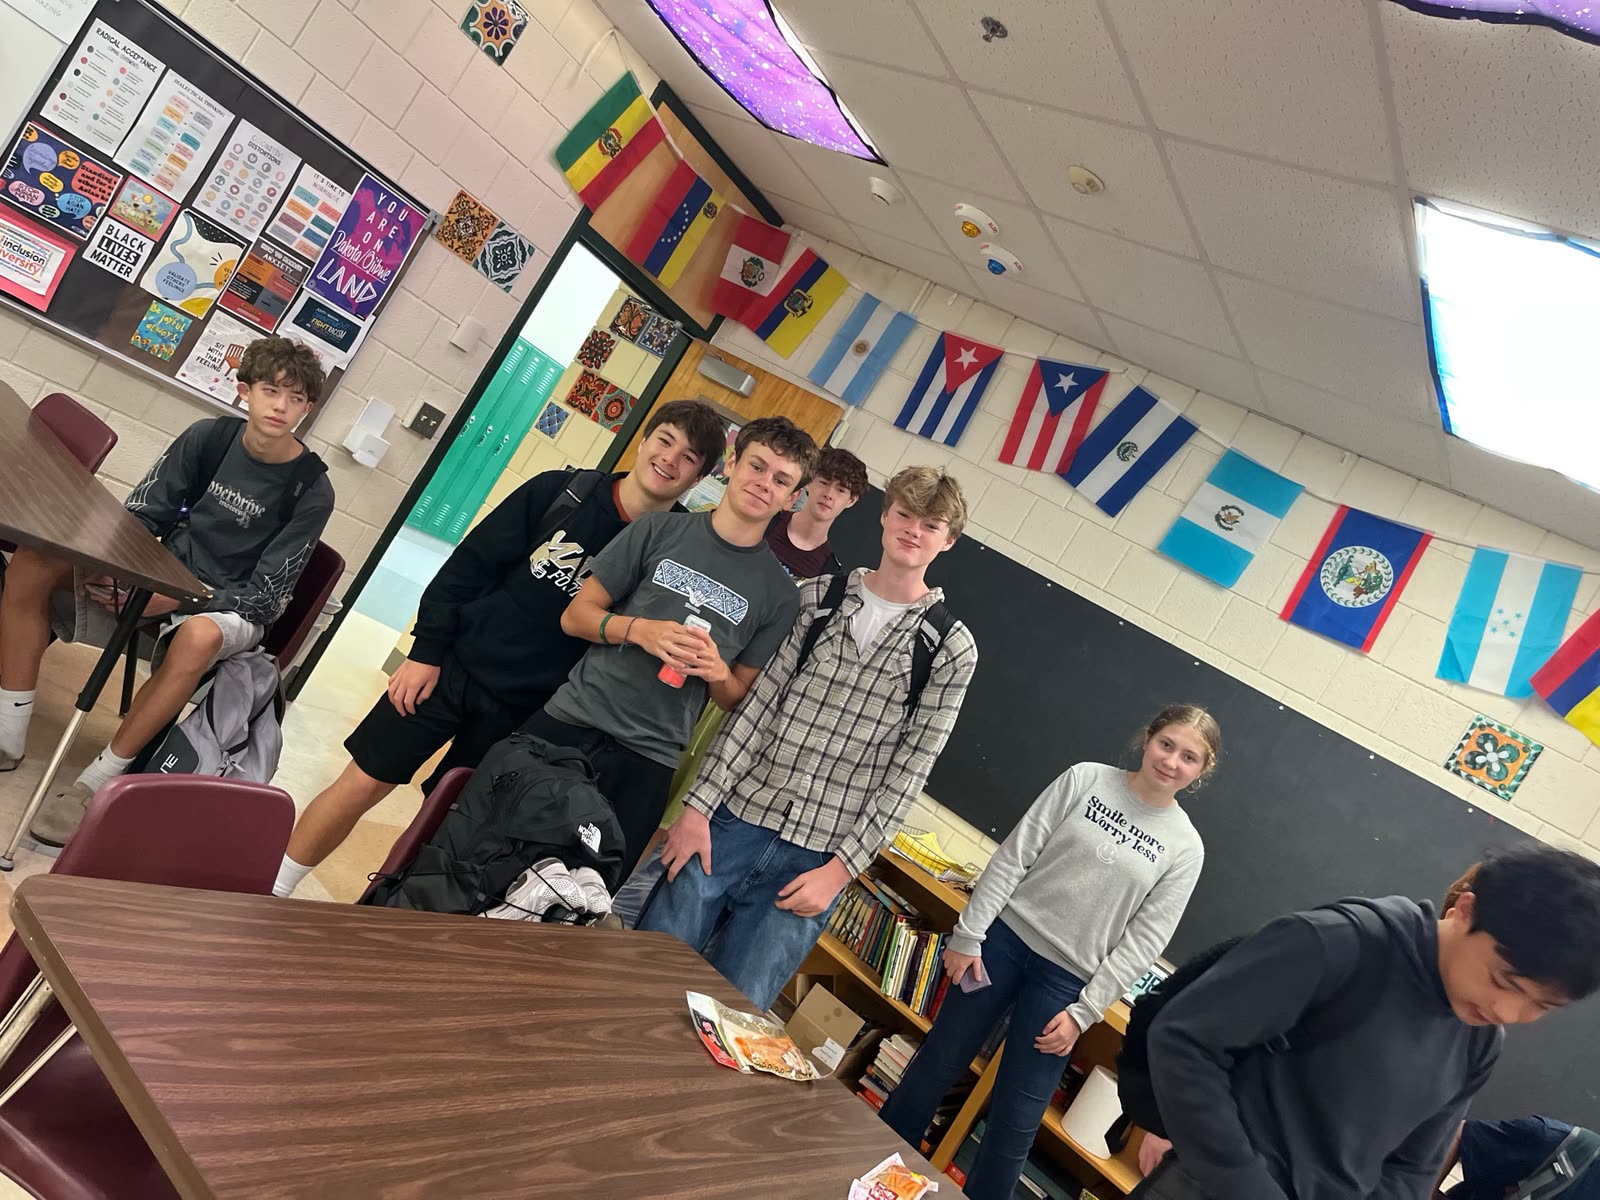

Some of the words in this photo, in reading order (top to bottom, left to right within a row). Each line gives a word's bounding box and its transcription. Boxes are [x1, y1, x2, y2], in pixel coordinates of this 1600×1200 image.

[95, 27, 122, 48] RADICAL
[121, 44, 158, 73] ACCEPTANCE
[174, 79, 202, 102] DIALECTICAL
[204, 98, 225, 118] THINKING
[248, 140, 282, 166] DISTORTIONS
[16, 187, 38, 201] ASIAN
[18, 182, 40, 195] STOP
[312, 173, 325, 183] IT'S
[324, 180, 338, 192] TIME
[337, 189, 345, 197] TO
[14, 191, 34, 203] HATE
[66, 200, 84, 210] ASIAN
[68, 194, 86, 203] STOP
[377, 192, 409, 222] YOU
[66, 206, 81, 215] HATE
[366, 211, 398, 239] ARE
[105, 224, 147, 254] BLACK
[362, 232, 384, 252] ON
[3, 238, 46, 265] inclusion
[101, 237, 138, 264] LIVES
[90, 248, 132, 278] MATTER
[261, 252, 294, 275] ANXIETY
[162, 278, 186, 294] FEELINGS
[168, 268, 191, 284] VALIDATE
[316, 258, 378, 304] LAND
[158, 313, 186, 332] joyful
[208, 346, 224, 358] WITH
[214, 341, 226, 350] SIT
[196, 356, 222, 374] FEELING
[204, 352, 222, 364] THAT
[1084, 806, 1132, 846] Worry
[1132, 839, 1157, 863] less
[1088, 795, 1128, 828] Smile
[1128, 824, 1165, 854] more
